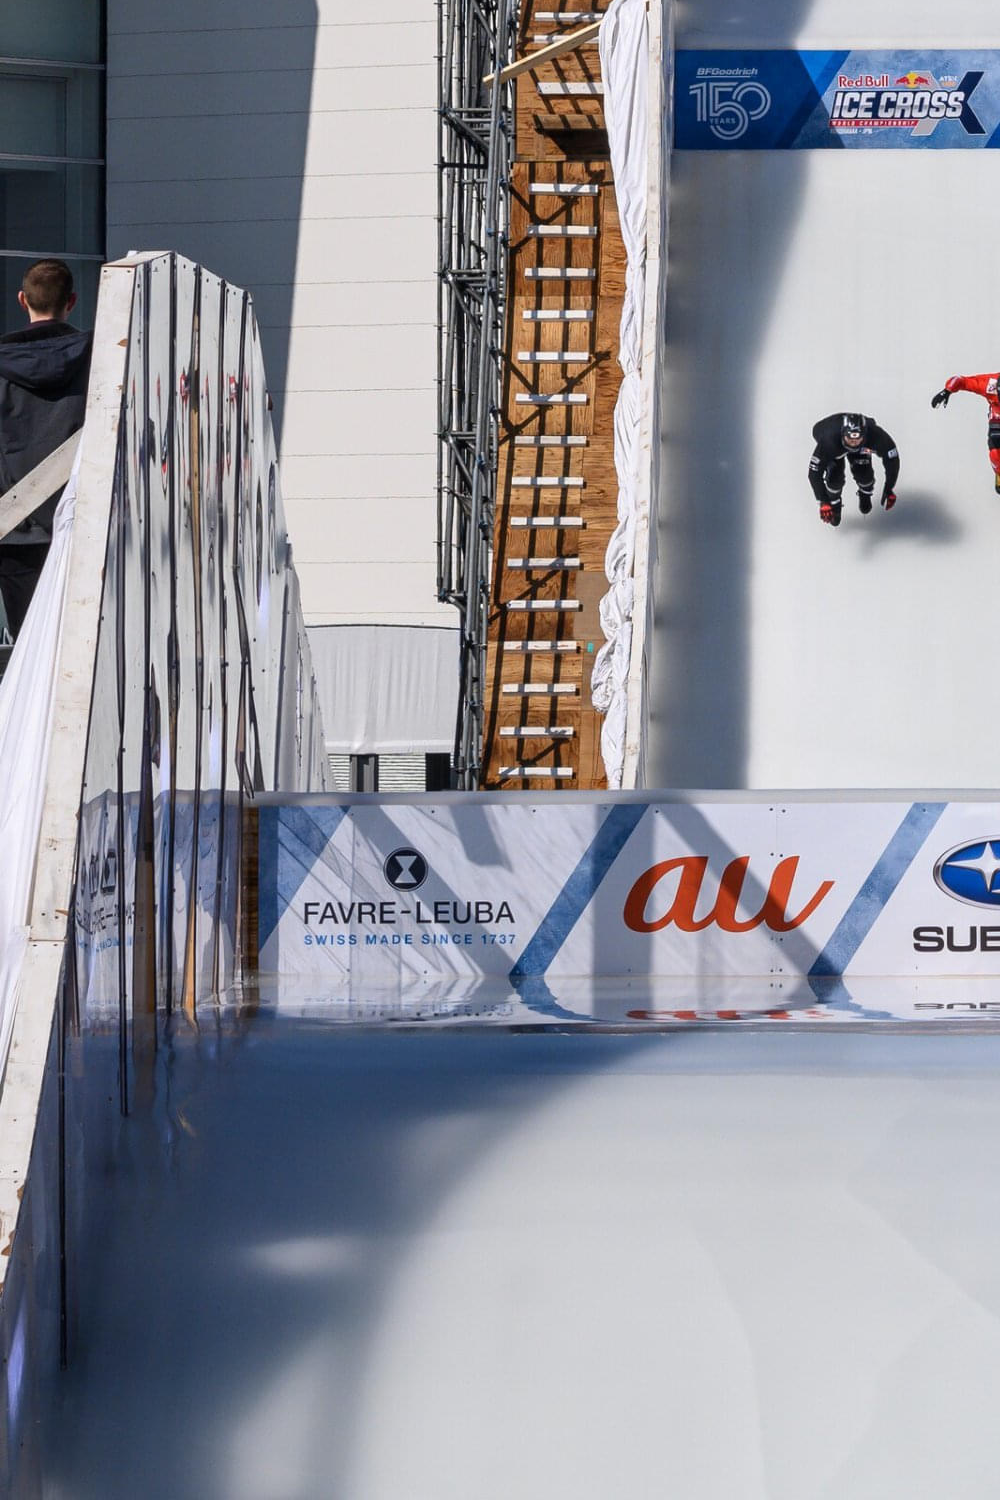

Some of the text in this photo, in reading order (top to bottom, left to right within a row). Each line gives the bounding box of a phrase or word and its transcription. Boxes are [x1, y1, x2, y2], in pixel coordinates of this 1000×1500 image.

[697, 68, 758, 76] BFGoodrich
[838, 75, 888, 87] Red Bull
[689, 82, 771, 140] 150
[832, 92, 965, 119] ICE CROSS
[709, 117, 735, 125] YEARS
[622, 855, 835, 934] au
[303, 902, 515, 925] FAVRE-LEUBA
[304, 934, 516, 946] SWISS MADE SINCE 1737
